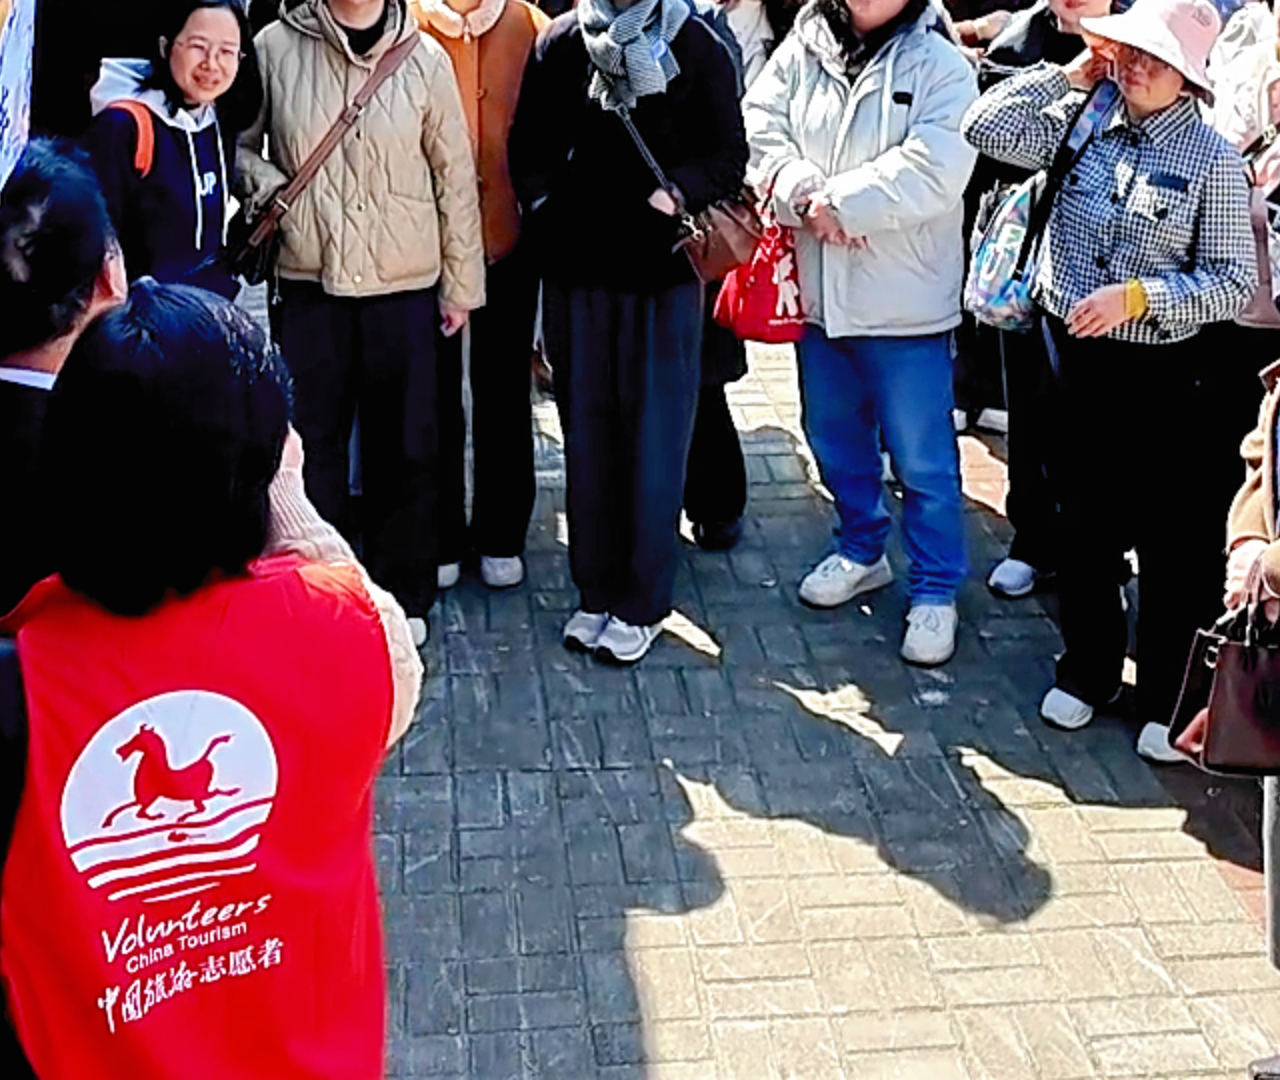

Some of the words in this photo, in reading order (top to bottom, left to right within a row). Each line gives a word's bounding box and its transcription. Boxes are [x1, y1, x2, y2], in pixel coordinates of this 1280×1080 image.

[101, 894, 272, 963] Volunteers
[126, 943, 174, 973] China
[177, 922, 247, 951] Tourism
[97, 937, 284, 1034] 中国旅游志愿者
